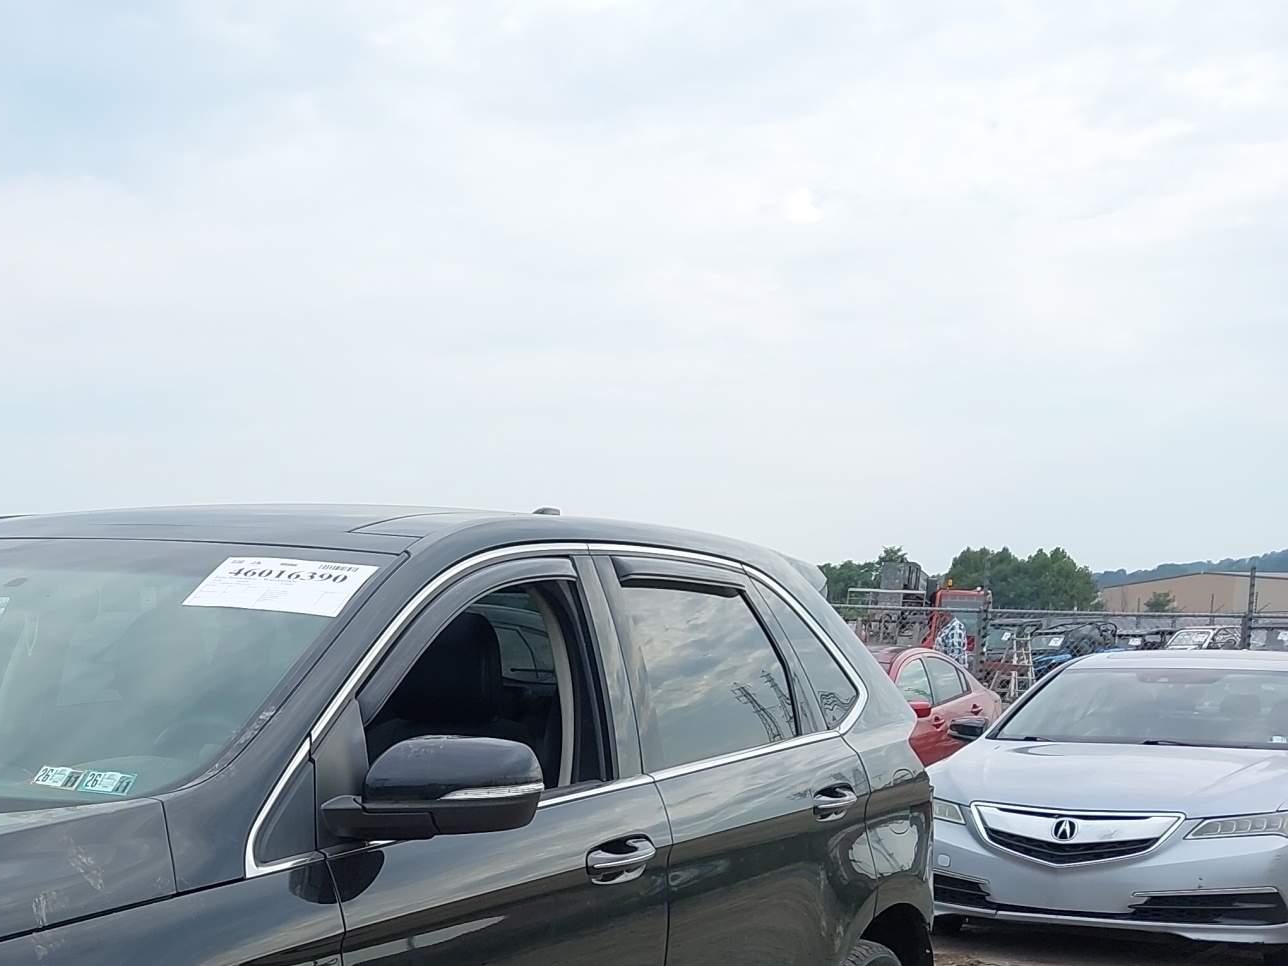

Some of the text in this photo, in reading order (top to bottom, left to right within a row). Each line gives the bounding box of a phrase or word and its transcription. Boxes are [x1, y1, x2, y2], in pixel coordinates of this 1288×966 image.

[228, 566, 349, 584] 46016390
[35, 768, 54, 783] 26
[85, 773, 102, 788] 26
